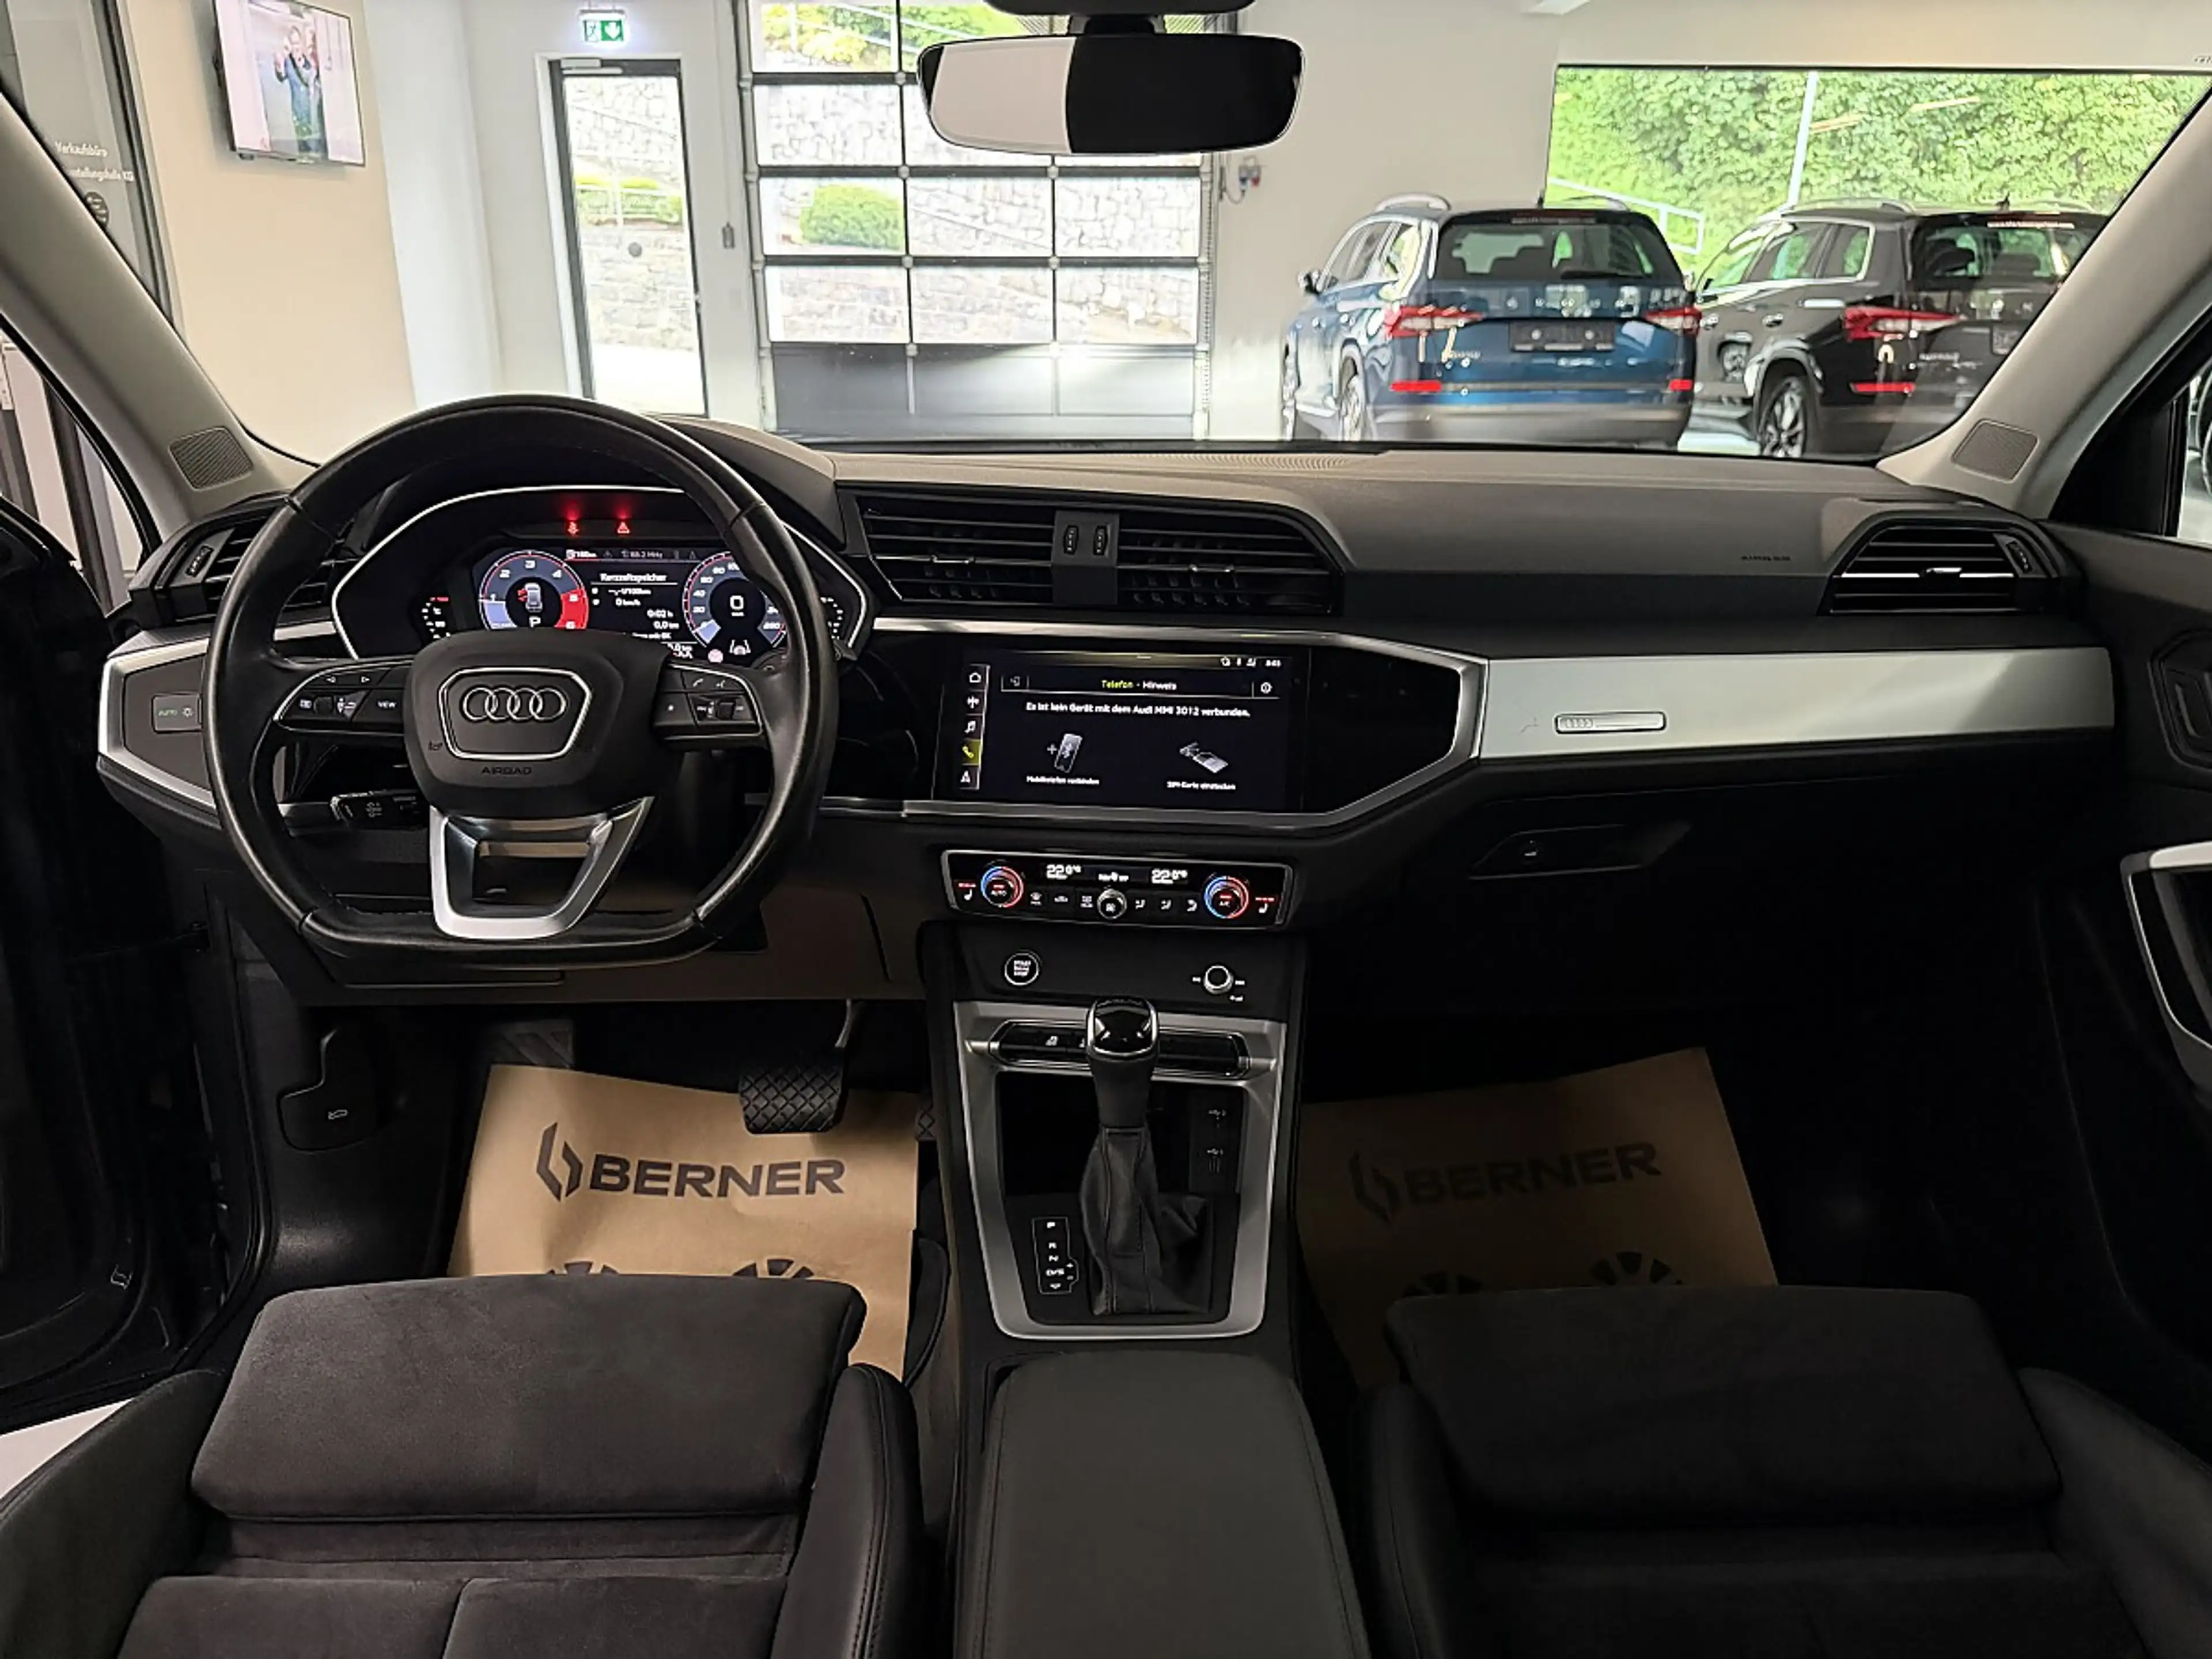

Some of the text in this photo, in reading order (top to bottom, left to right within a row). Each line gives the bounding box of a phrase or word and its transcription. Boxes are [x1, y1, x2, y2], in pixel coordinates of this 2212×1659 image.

[1101, 680, 1134, 689] Telefon
[1026, 702, 1036, 711] Es
[1095, 704, 1111, 713] mit
[1112, 704, 1131, 714] dem
[1132, 704, 1153, 714] Audi
[589, 1153, 846, 1198] BERNER
[1404, 1142, 1662, 1206] BERNER
